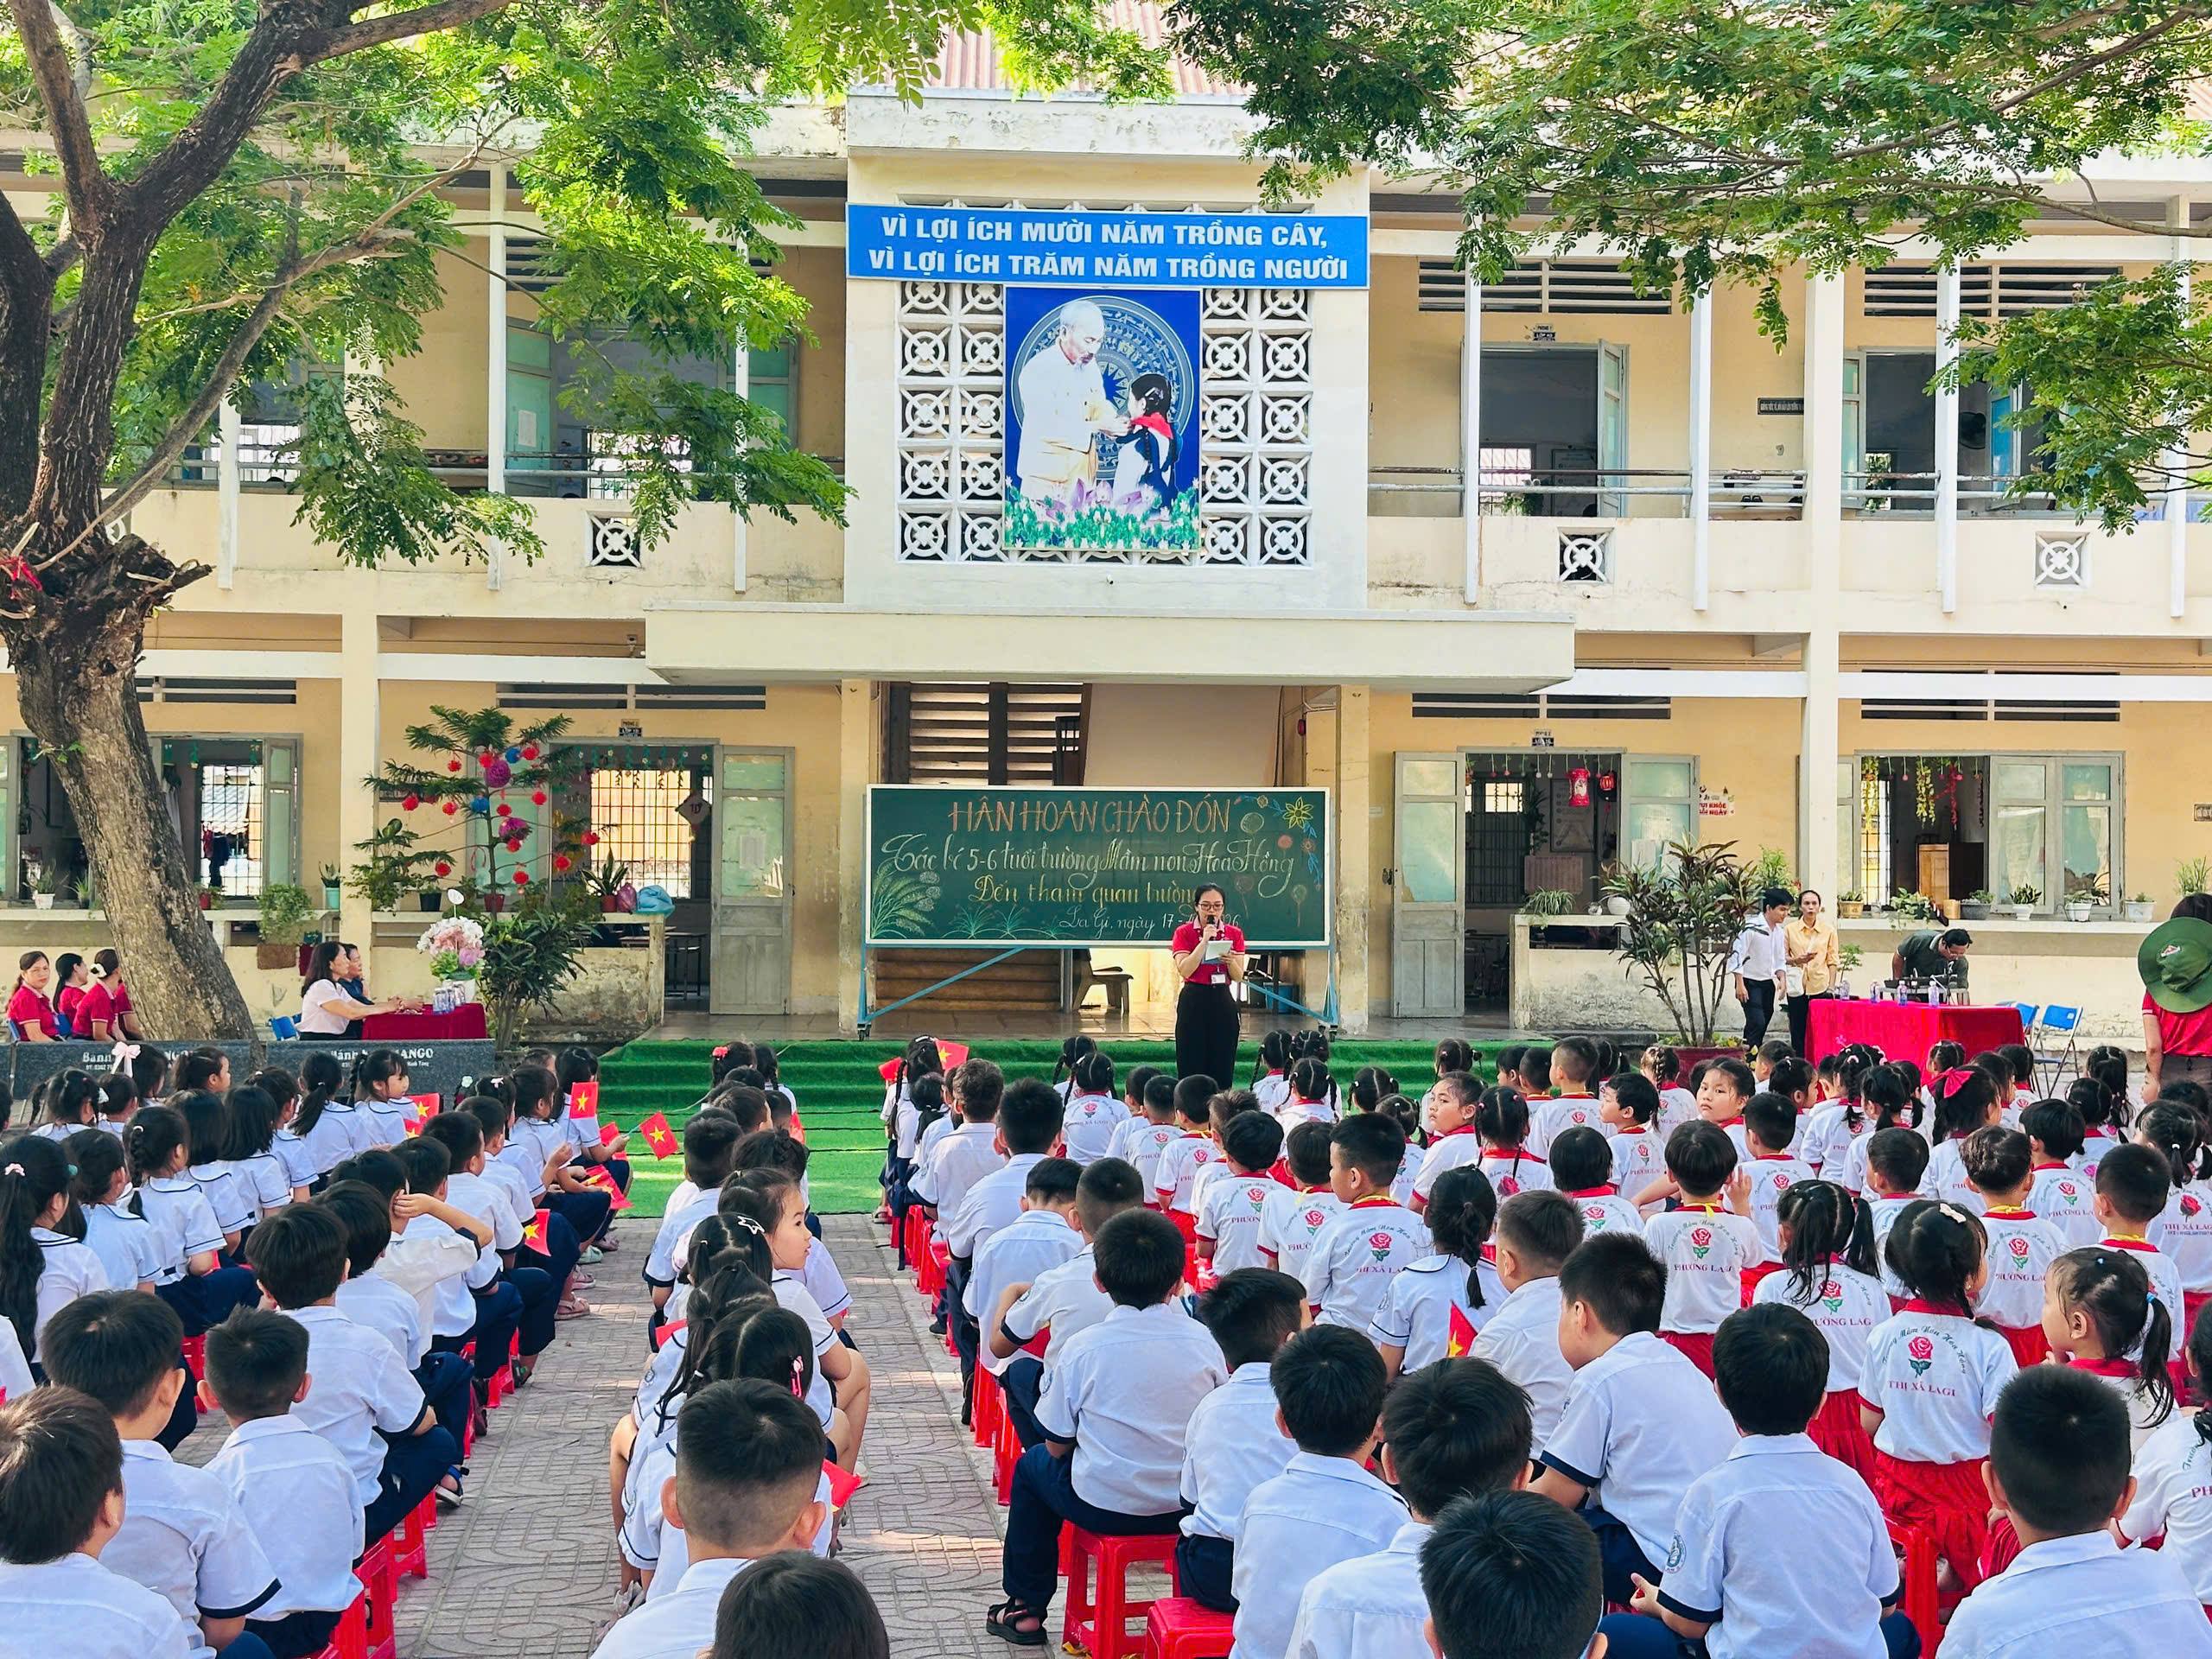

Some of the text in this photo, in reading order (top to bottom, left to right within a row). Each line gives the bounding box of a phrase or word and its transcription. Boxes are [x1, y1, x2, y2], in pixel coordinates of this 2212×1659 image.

[881, 213, 1327, 249] VÌ LỢI ÍCH MƯỜI NĂM TRỒNG CÂY,
[868, 246, 1348, 279] VÌ LỢI ÍCH TRĂM NĂM TRỒNG NGƯỜI
[948, 793, 1230, 833] HÂN HOAN CHÀO ĐÓN
[967, 849, 997, 871] 5-6
[1001, 841, 1037, 870] tuổi
[1099, 837, 1147, 872] Mầm
[1154, 854, 1189, 872] non
[1183, 840, 1232, 874] Hoa
[1227, 839, 1294, 898] Hồng
[969, 874, 1195, 916] Đến tham quan trườn
[1059, 906, 1089, 929] La
[1117, 914, 1154, 939] ngày
[395, 1047, 434, 1059] ANGO
[1231, 1215, 1261, 1224] PHƯỜN
[1815, 1316, 1847, 1326] ƯỜNG
[1887, 1380, 1956, 1397] THỊ XÃ LAGI
